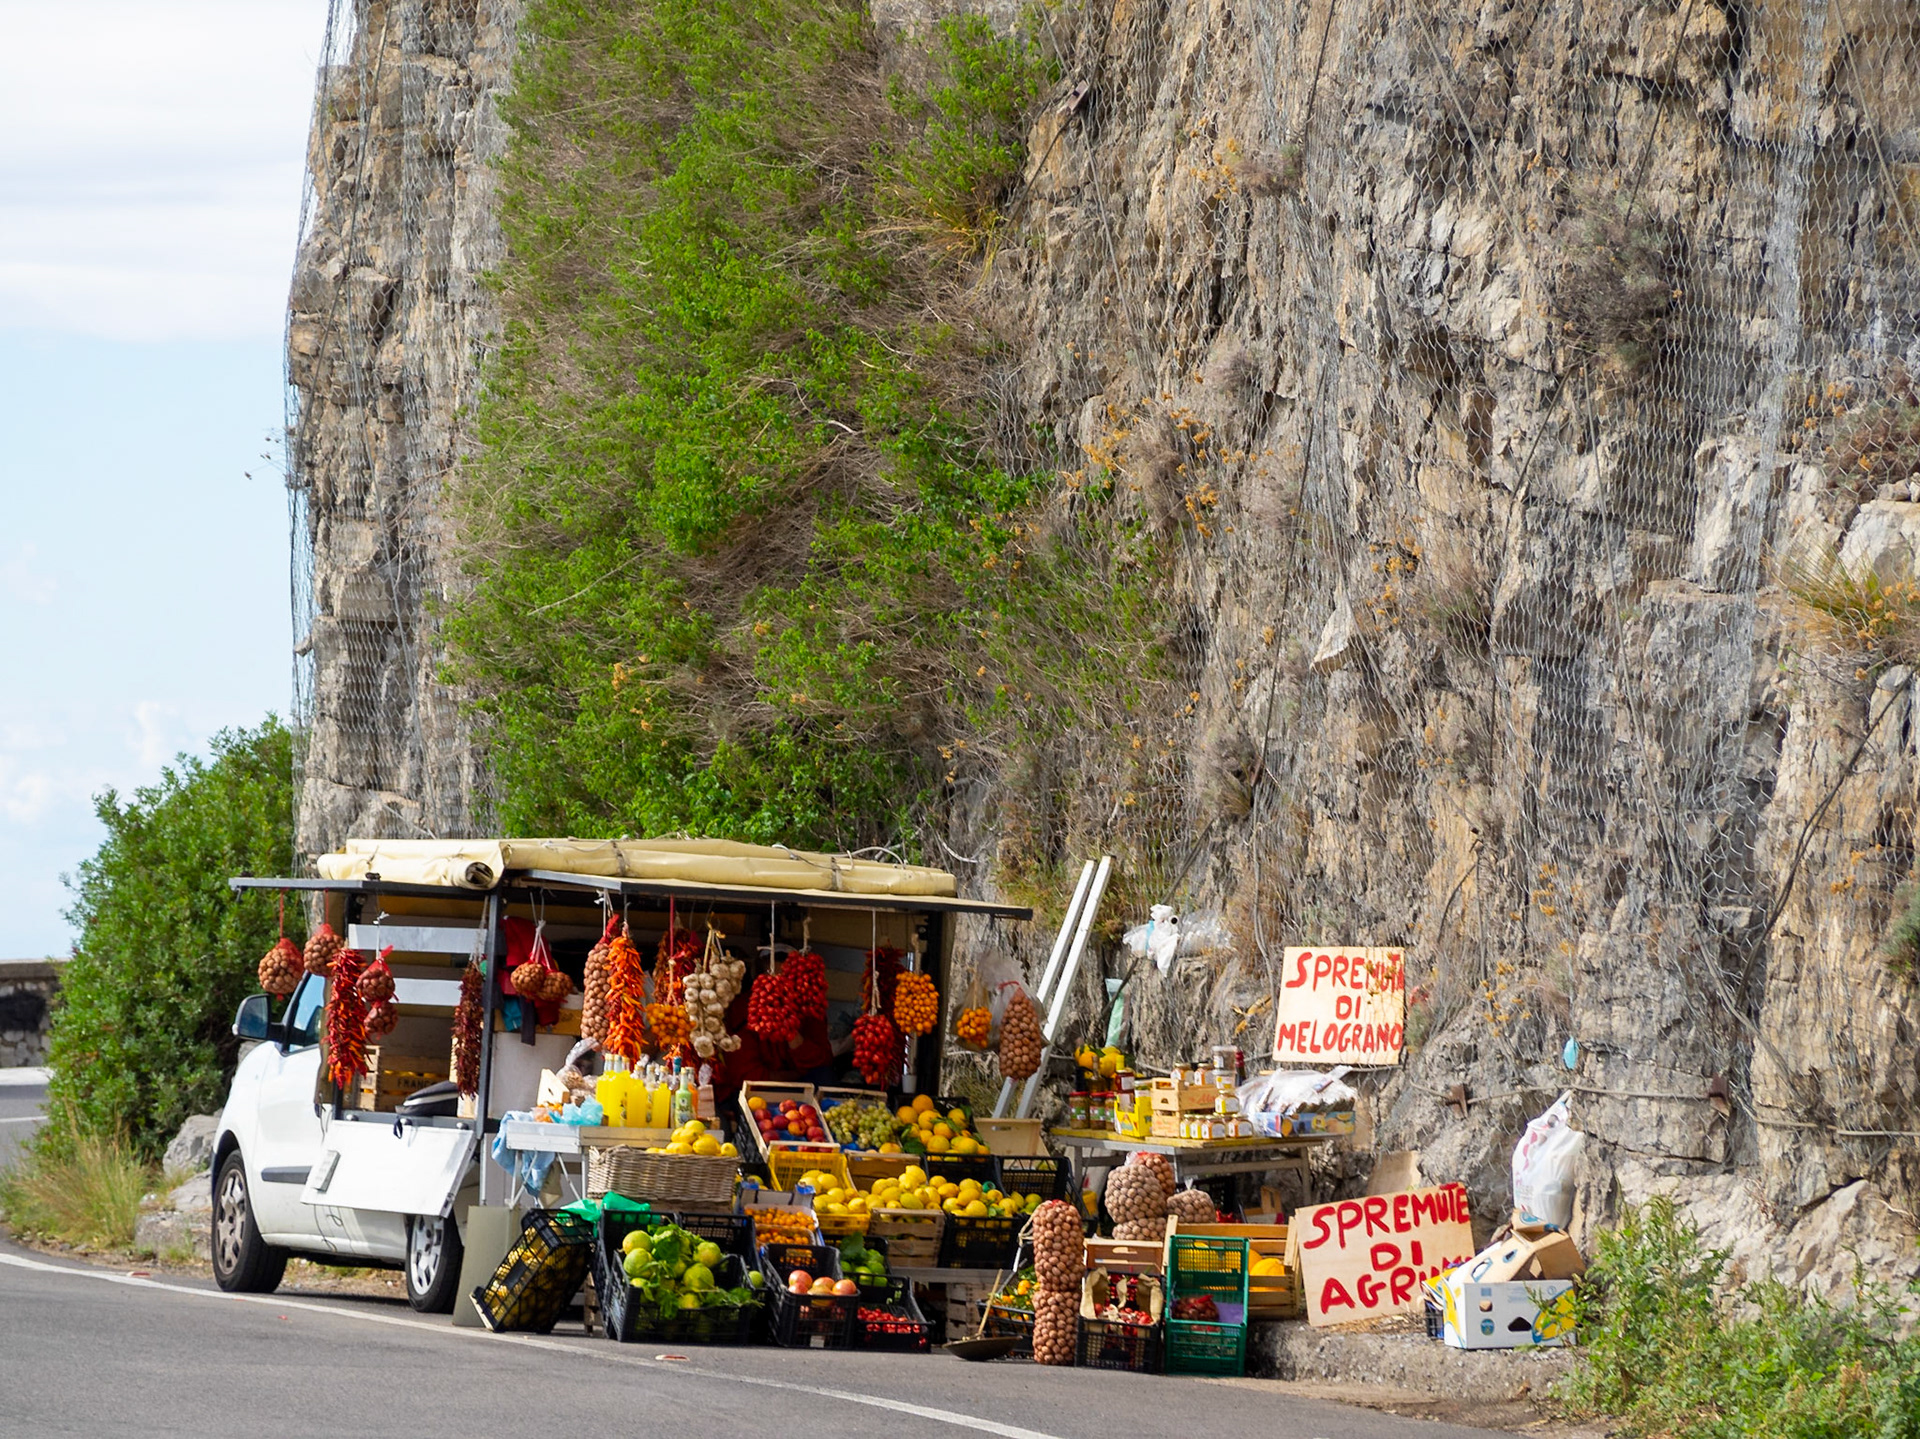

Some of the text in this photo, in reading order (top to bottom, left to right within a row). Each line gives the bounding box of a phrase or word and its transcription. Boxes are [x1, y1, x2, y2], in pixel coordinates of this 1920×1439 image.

[1335, 995, 1361, 1020] DI
[1277, 1019, 1404, 1054] MELOGRANO
[1303, 1182, 1470, 1249] SPREMUTE
[1370, 1240, 1424, 1272] DI
[1320, 1256, 1475, 1315] AGR
